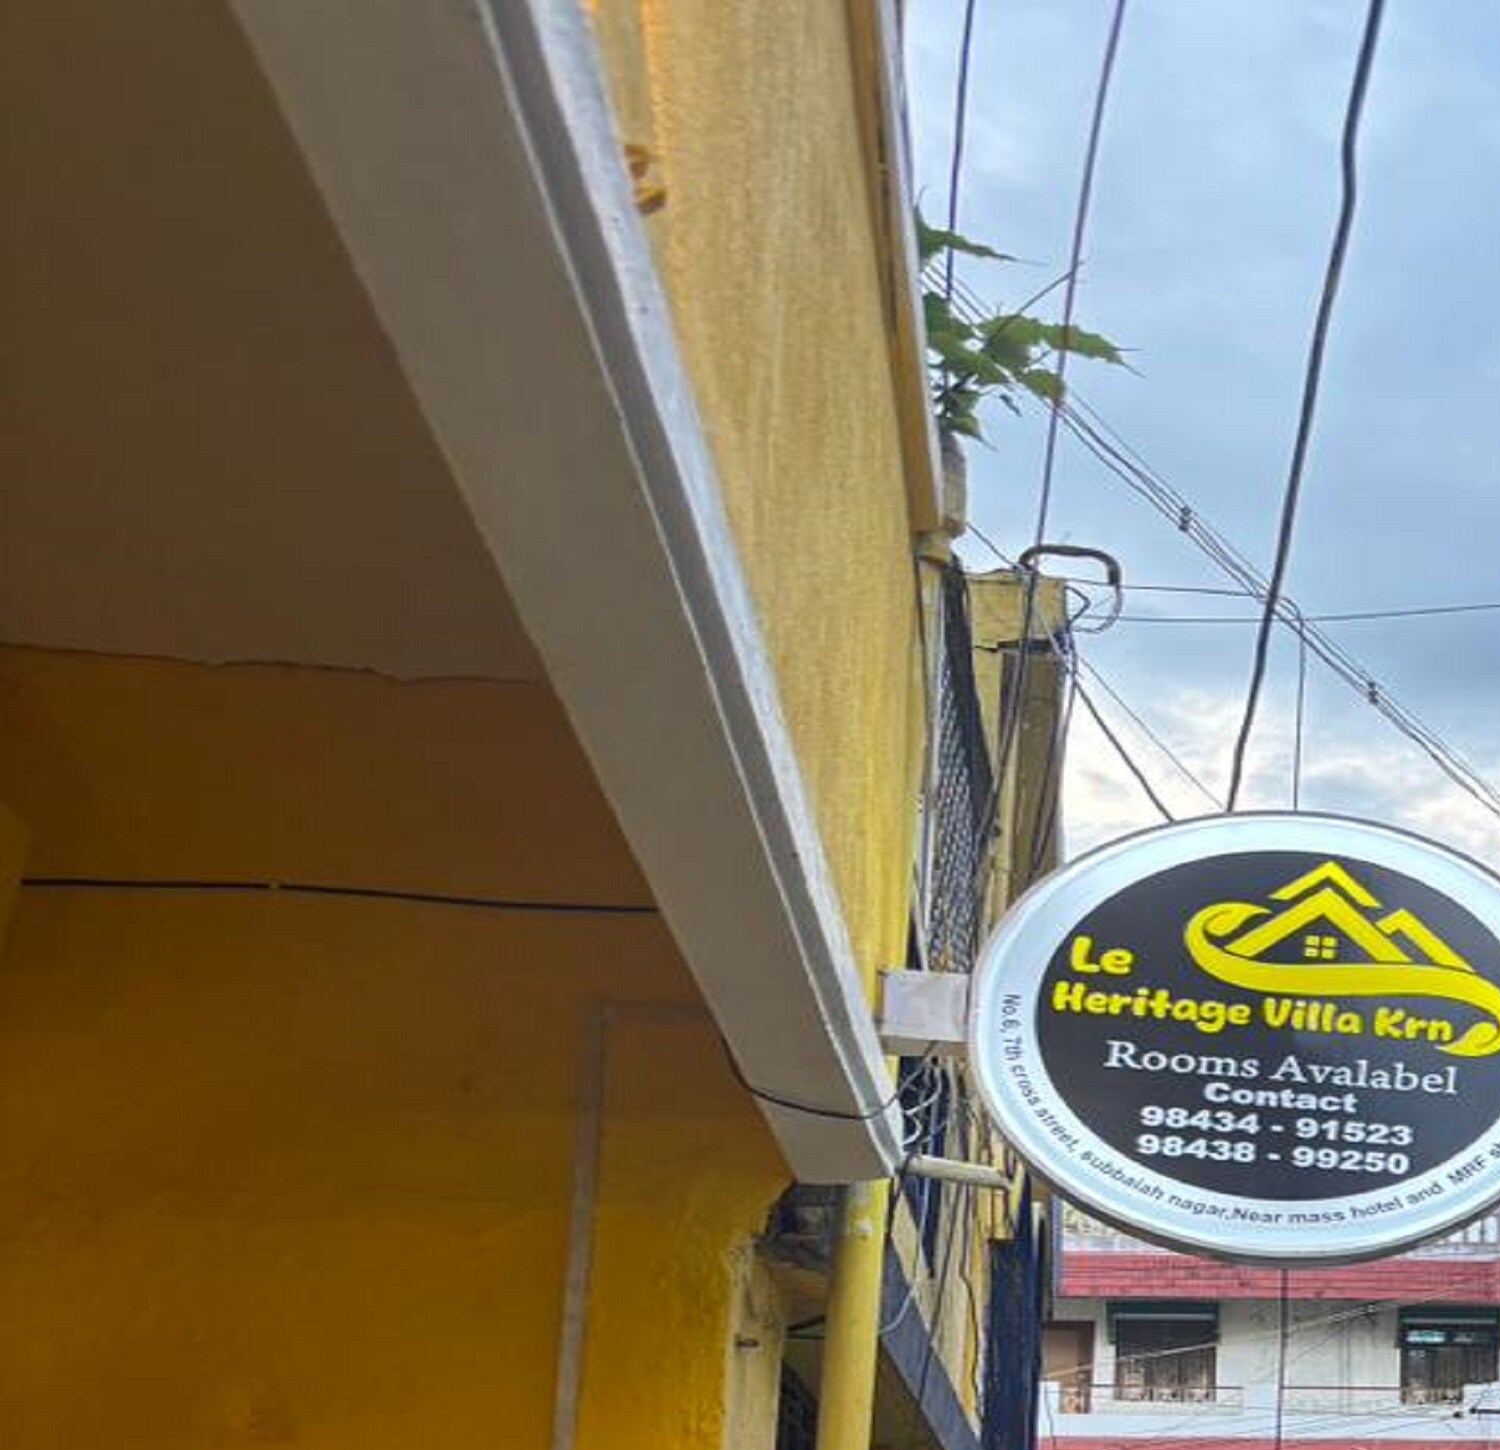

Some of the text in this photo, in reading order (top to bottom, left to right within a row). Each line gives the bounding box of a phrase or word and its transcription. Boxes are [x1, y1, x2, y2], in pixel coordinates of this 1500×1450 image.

[1070, 935, 1133, 974] Le
[1053, 980, 1452, 1041] Heritage Villa Krn
[1103, 1040, 1458, 1094] Rooms Avalabel
[1203, 1081, 1357, 1113] Contact
[1010, 1063, 1040, 1106] cross
[1289, 1210, 1345, 1224] mass
[1350, 1196, 1403, 1218] hotel
[1405, 1180, 1444, 1204] and
[1447, 1155, 1487, 1186] MRF
[1140, 1105, 1260, 1134] 98434
[1295, 1117, 1413, 1145] 91523
[1136, 1133, 1256, 1163] 98438
[1291, 1146, 1409, 1175] 99250
